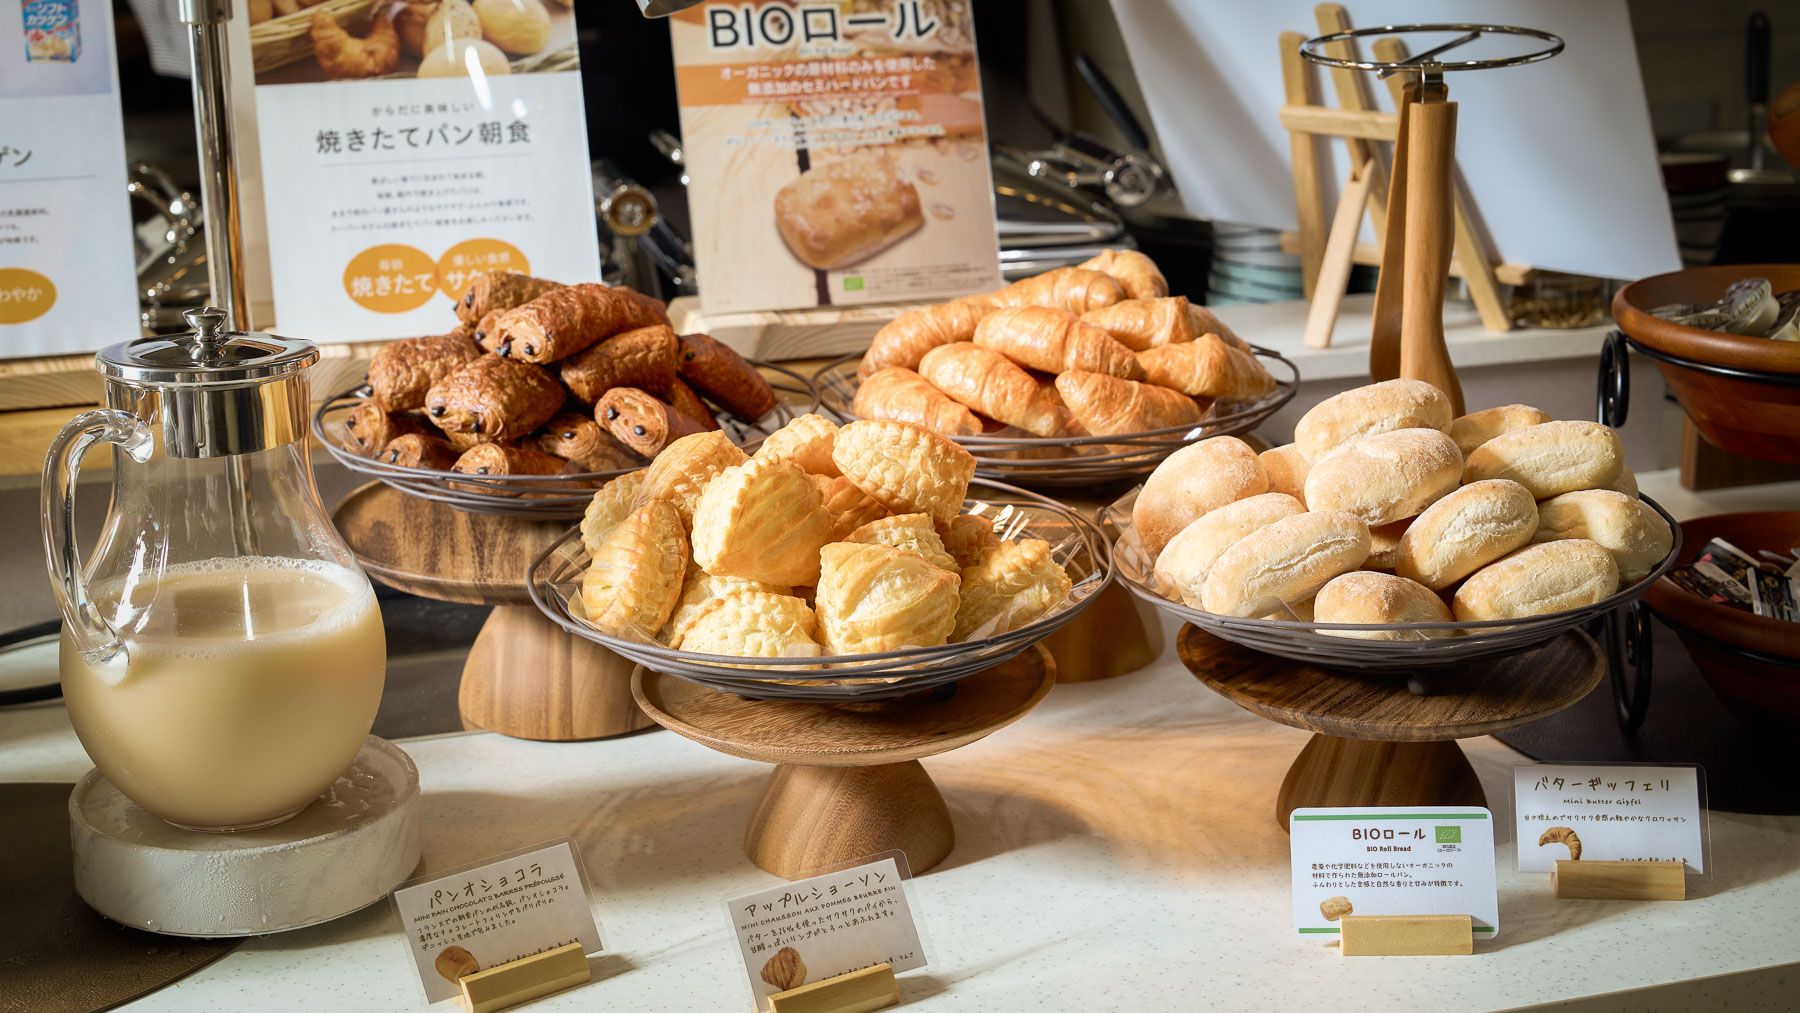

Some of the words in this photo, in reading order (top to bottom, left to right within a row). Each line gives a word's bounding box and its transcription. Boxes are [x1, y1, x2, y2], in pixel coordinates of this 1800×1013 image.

[709, 1, 936, 48] BIOロール
[746, 75, 912, 96] 無添加のセミハードパンです
[371, 102, 475, 117] からだに美味しい
[315, 119, 531, 154] 焼きたてパン朝食
[351, 273, 433, 298] 焼きたて
[1534, 776, 1670, 792] バターギッフェリ
[1616, 797, 1642, 806] Gipfel
[1352, 827, 1427, 841] BIOロール
[1311, 862, 1453, 870] 農薬や化学肥料などを使用しないオーガニックの
[429, 863, 541, 909] パンオショコラ
[744, 872, 886, 917] アップルショーソン
[414, 914, 431, 923] MINI
[431, 908, 449, 918] PAIN
[449, 897, 487, 912] CHOCOLAT
[493, 885, 524, 899] BARRES
[741, 921, 759, 931] MINI
[760, 910, 802, 926] CHAUSSON
[804, 905, 820, 914] AUX
[820, 897, 852, 909] POMMES
[853, 888, 882, 900] BEURRE
[883, 885, 896, 893] FIN
